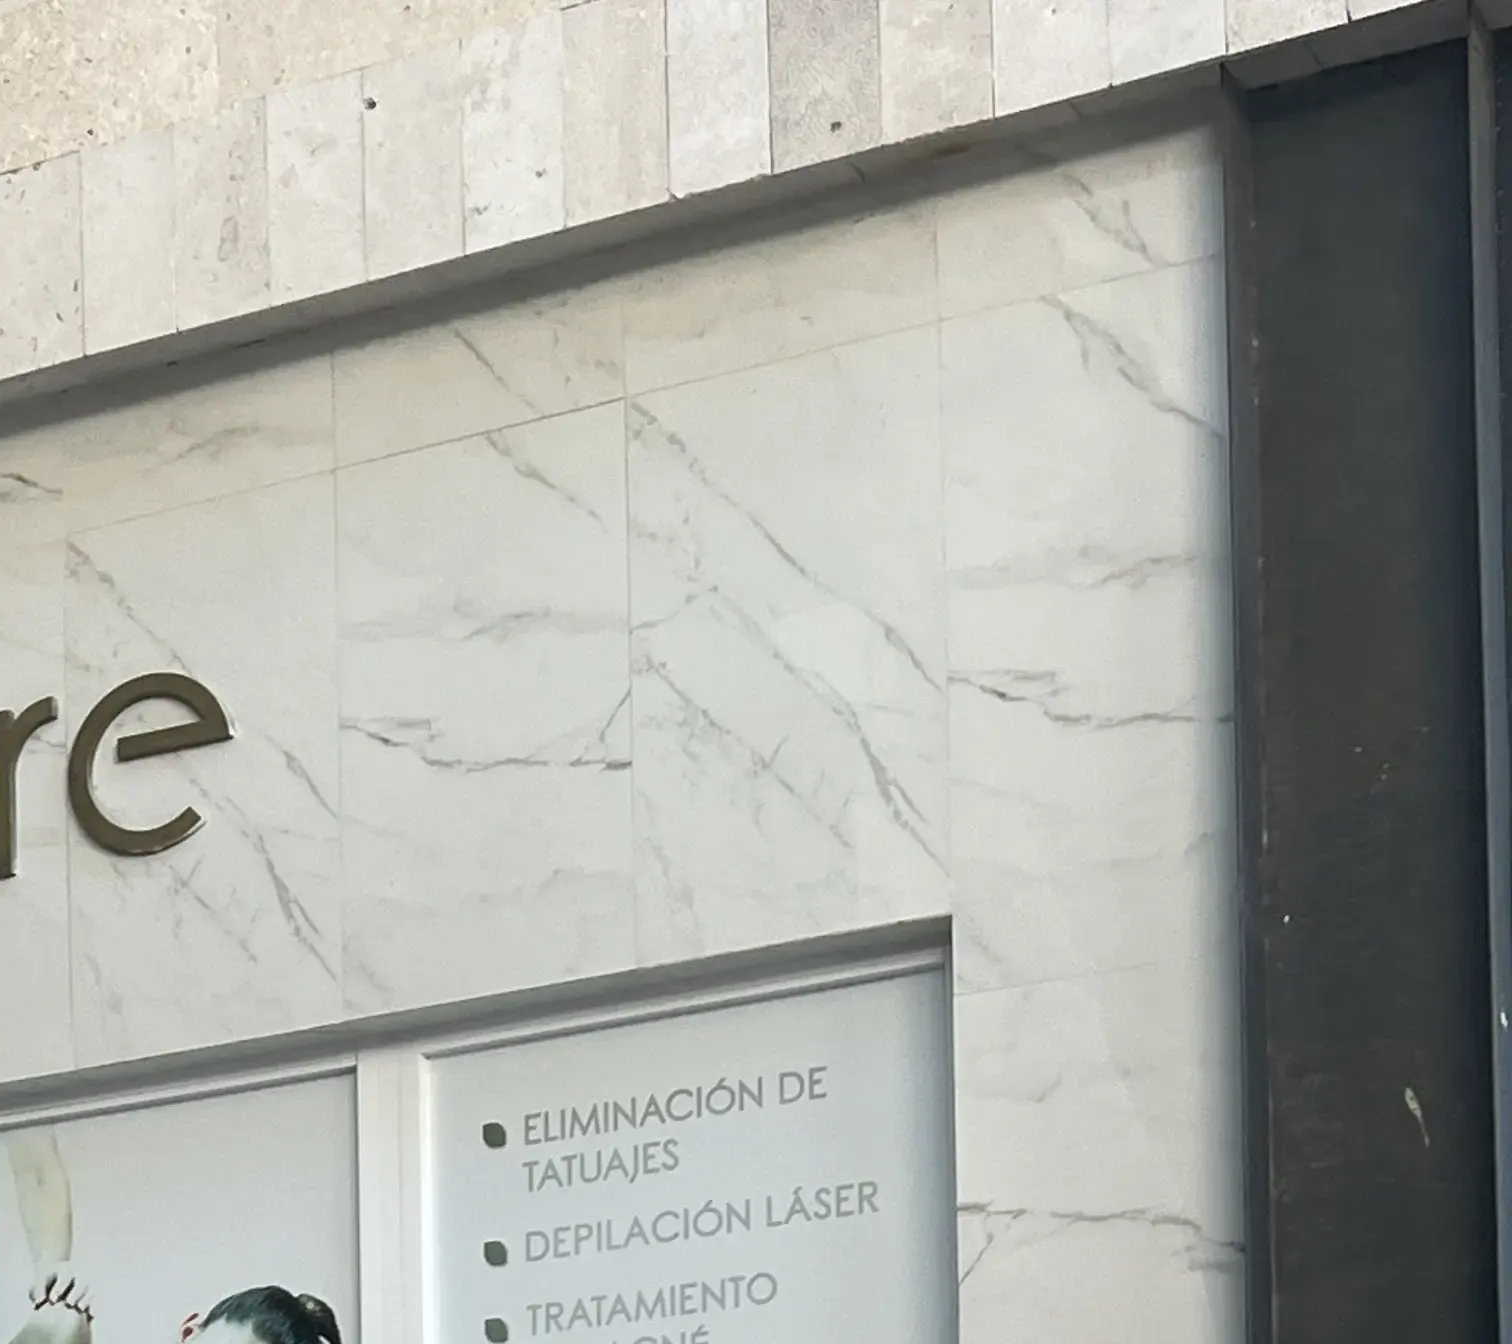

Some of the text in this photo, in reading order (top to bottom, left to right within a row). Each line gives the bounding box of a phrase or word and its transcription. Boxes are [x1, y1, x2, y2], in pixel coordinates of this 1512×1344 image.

[522, 1066, 829, 1146] ELIMINACIÓN DE
[523, 1139, 680, 1193] TATUAJES
[524, 1180, 879, 1263] DEPILACIÓN LÁSER
[526, 1271, 777, 1336] TRATAMIENTO
